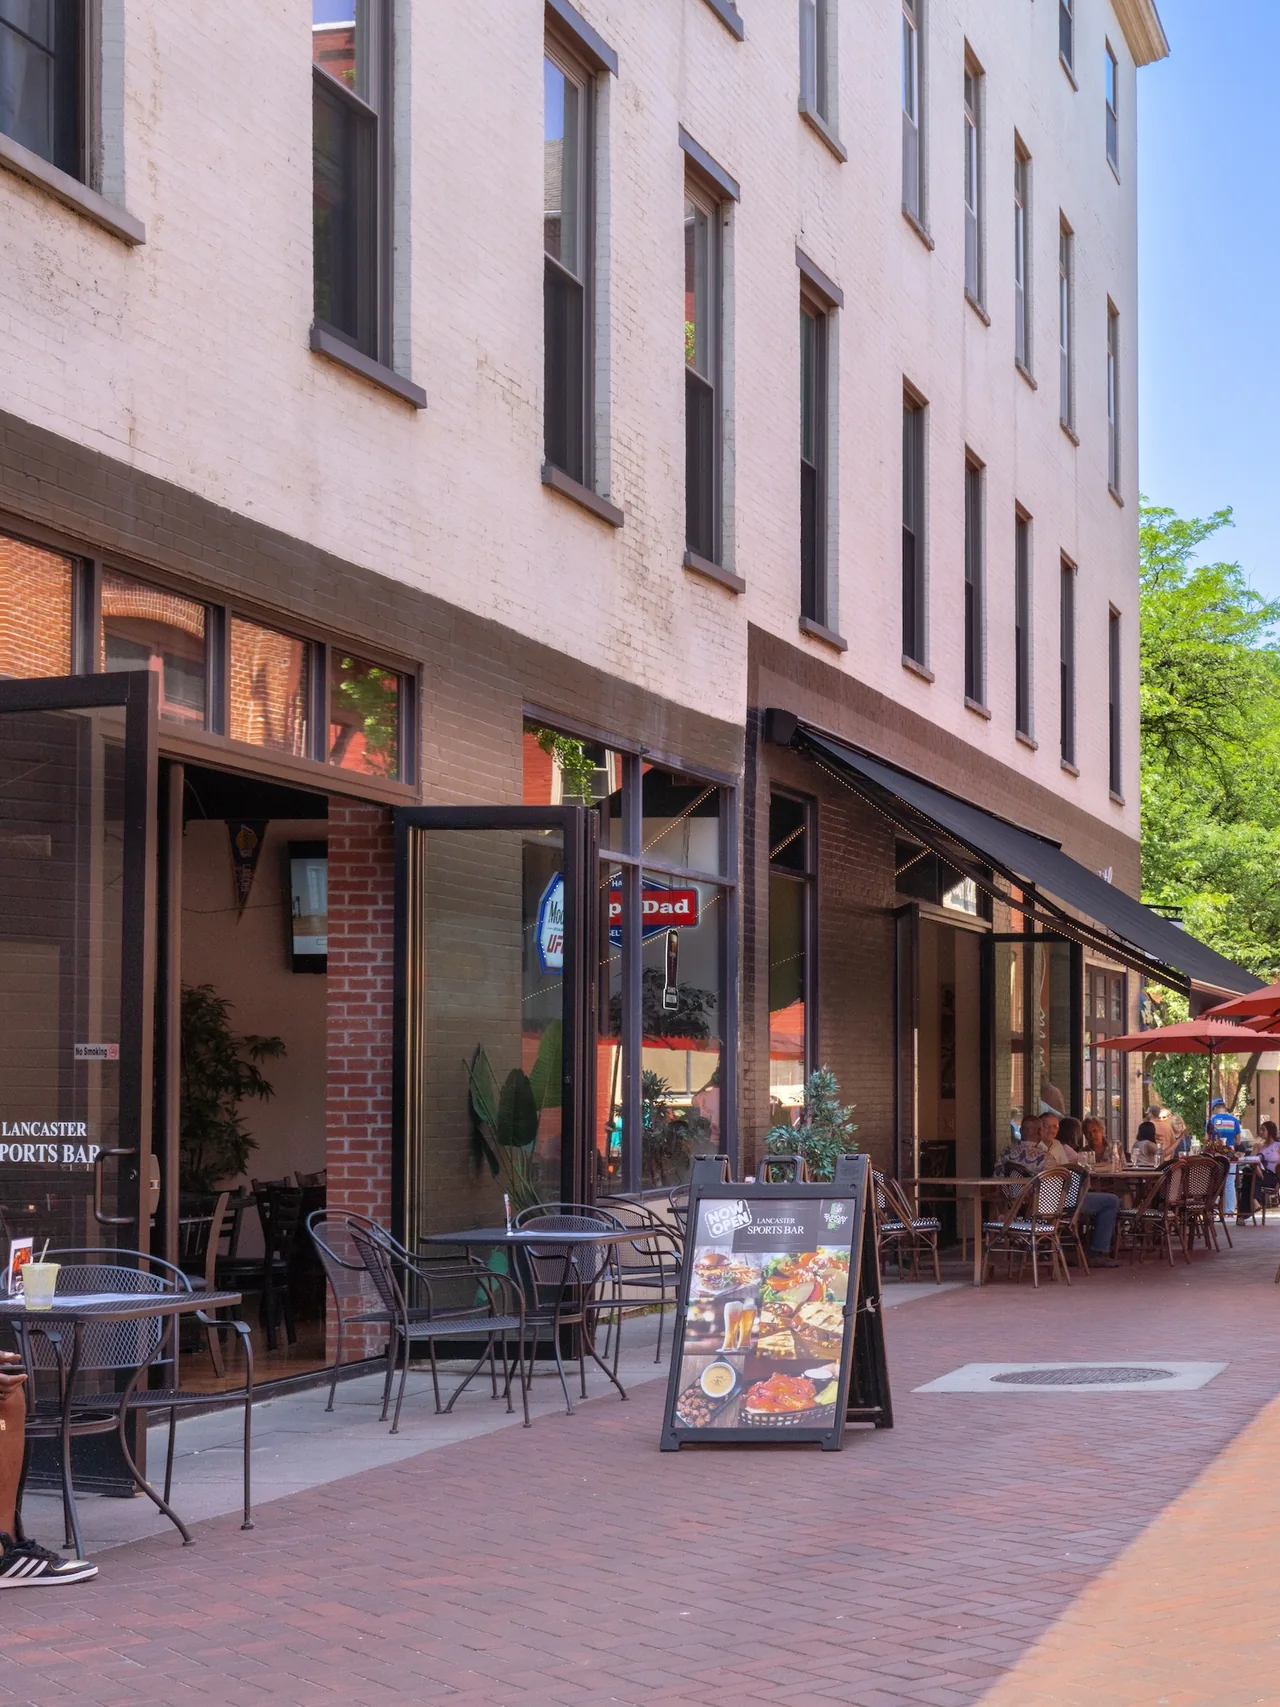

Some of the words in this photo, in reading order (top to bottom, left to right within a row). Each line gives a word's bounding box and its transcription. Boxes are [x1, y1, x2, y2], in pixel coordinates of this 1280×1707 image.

[643, 899, 689, 914] Dad
[76, 1047, 82, 1055] No
[84, 1047, 108, 1057] Smoking
[2, 1122, 87, 1137] LANCASTER
[0, 1143, 58, 1162] PORTS
[708, 1201, 744, 1224] NOW
[712, 1216, 750, 1236] OPEN
[747, 1225, 782, 1235] SPORTS
[784, 1226, 804, 1234] BAR
